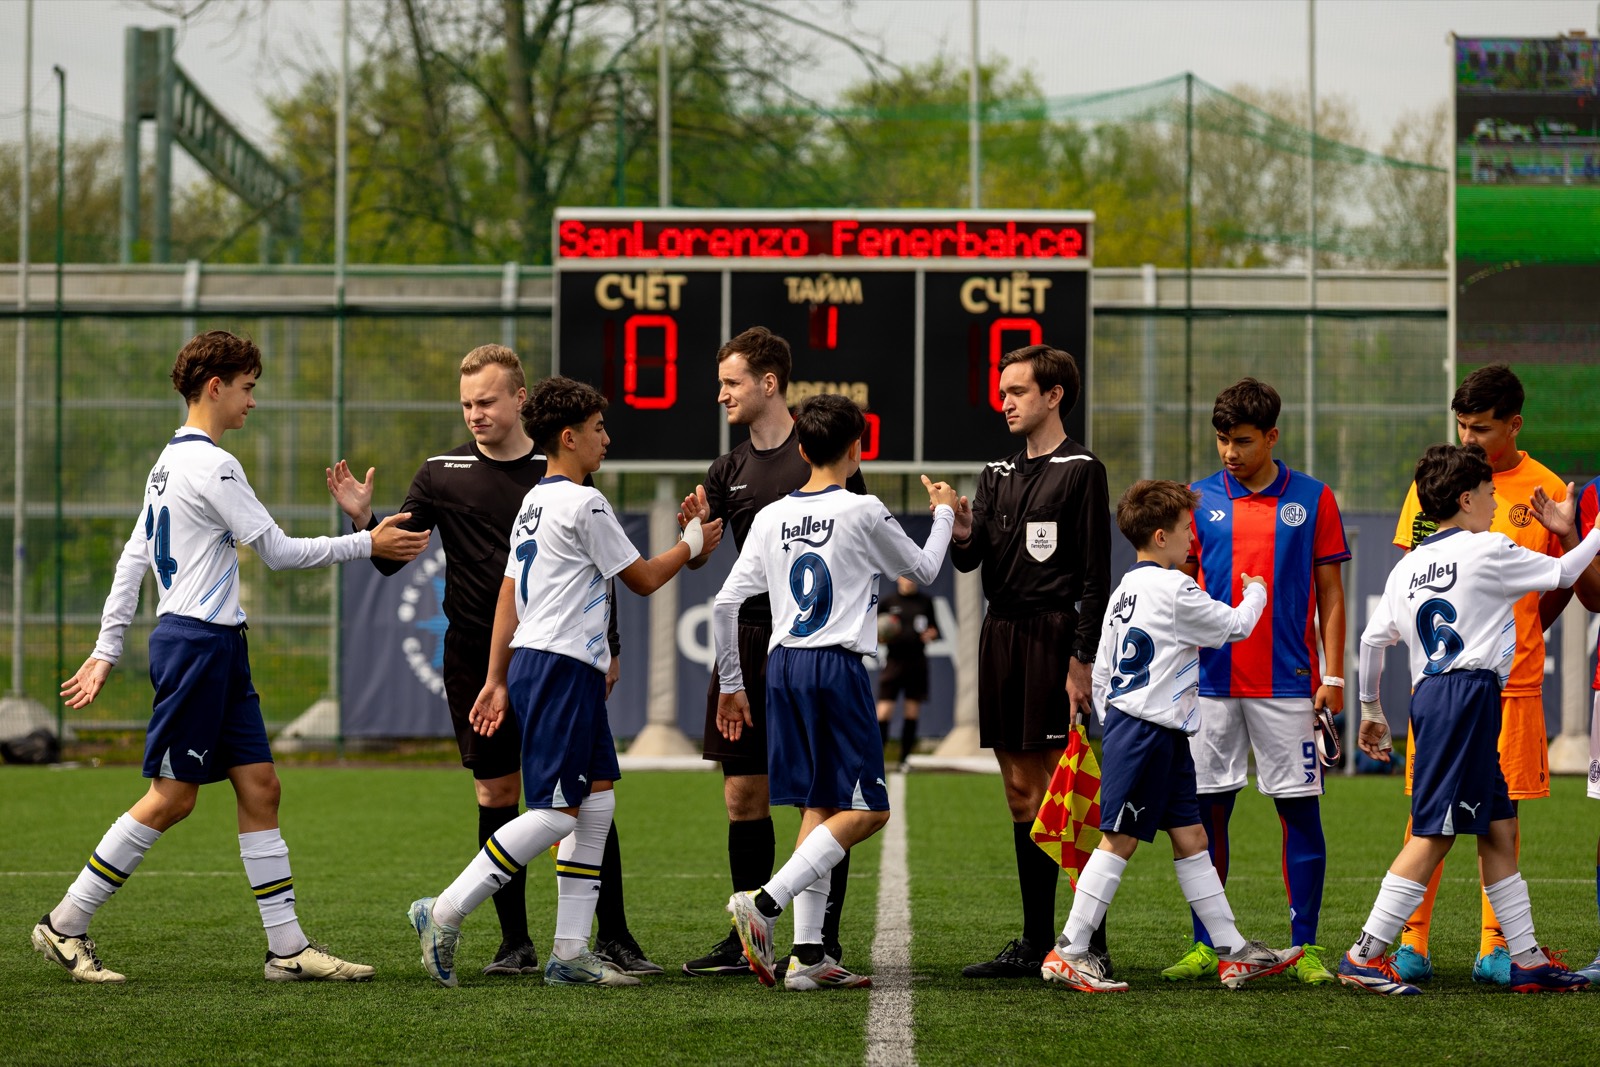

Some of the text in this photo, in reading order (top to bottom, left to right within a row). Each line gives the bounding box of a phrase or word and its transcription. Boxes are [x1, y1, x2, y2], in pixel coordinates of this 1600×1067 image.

[559, 220, 1082, 258] SanLorenzo Fenerbahce
[595, 270, 687, 311] СЧЁТ
[784, 273, 864, 304] ТАЙМ
[960, 271, 1052, 314] СЧЁТ
[624, 314, 678, 410] 0
[781, 515, 835, 548] halley
[515, 538, 538, 608] 7
[1408, 562, 1458, 593] halley
[788, 552, 834, 638] 9
[1416, 597, 1465, 676] 6
[1302, 741, 1317, 770] 9
